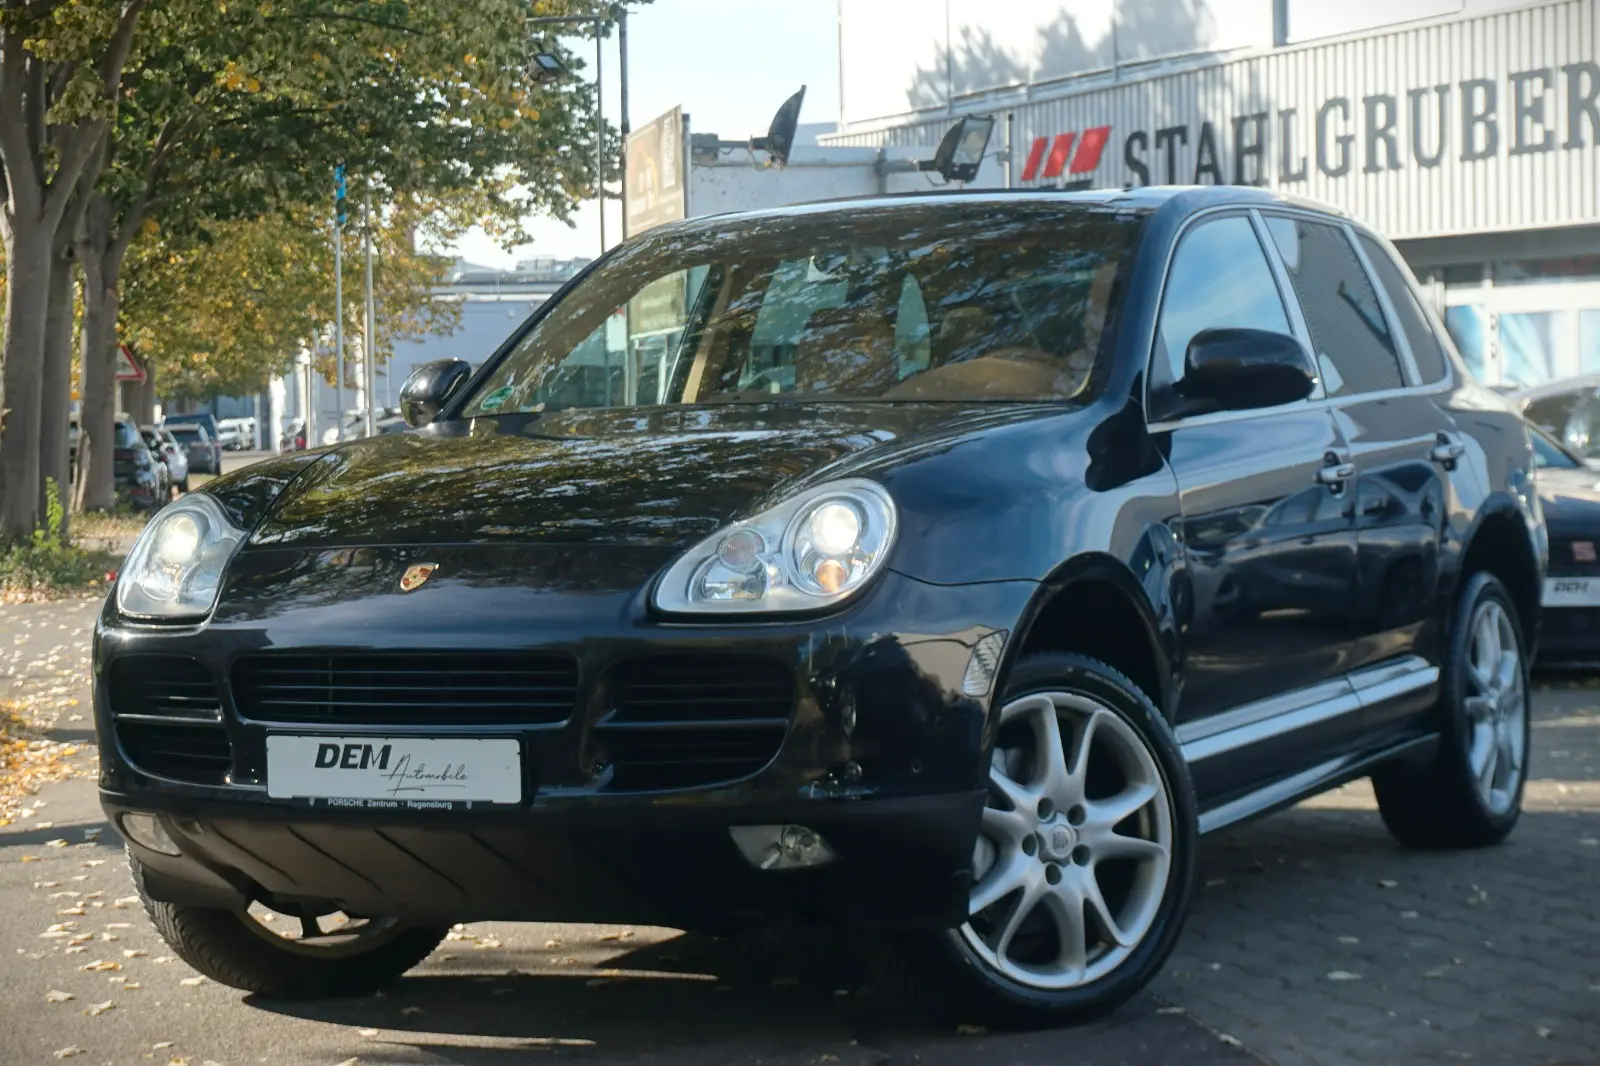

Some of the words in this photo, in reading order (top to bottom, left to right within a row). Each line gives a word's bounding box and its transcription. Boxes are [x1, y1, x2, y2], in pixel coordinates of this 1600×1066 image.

[1124, 63, 1600, 187] STAHLGRUBER
[314, 743, 392, 770] DEM
[381, 754, 468, 797] Automobile
[327, 798, 364, 808] PORSCHE
[367, 800, 398, 809] Zentrum
[407, 801, 453, 810] Regensburg
